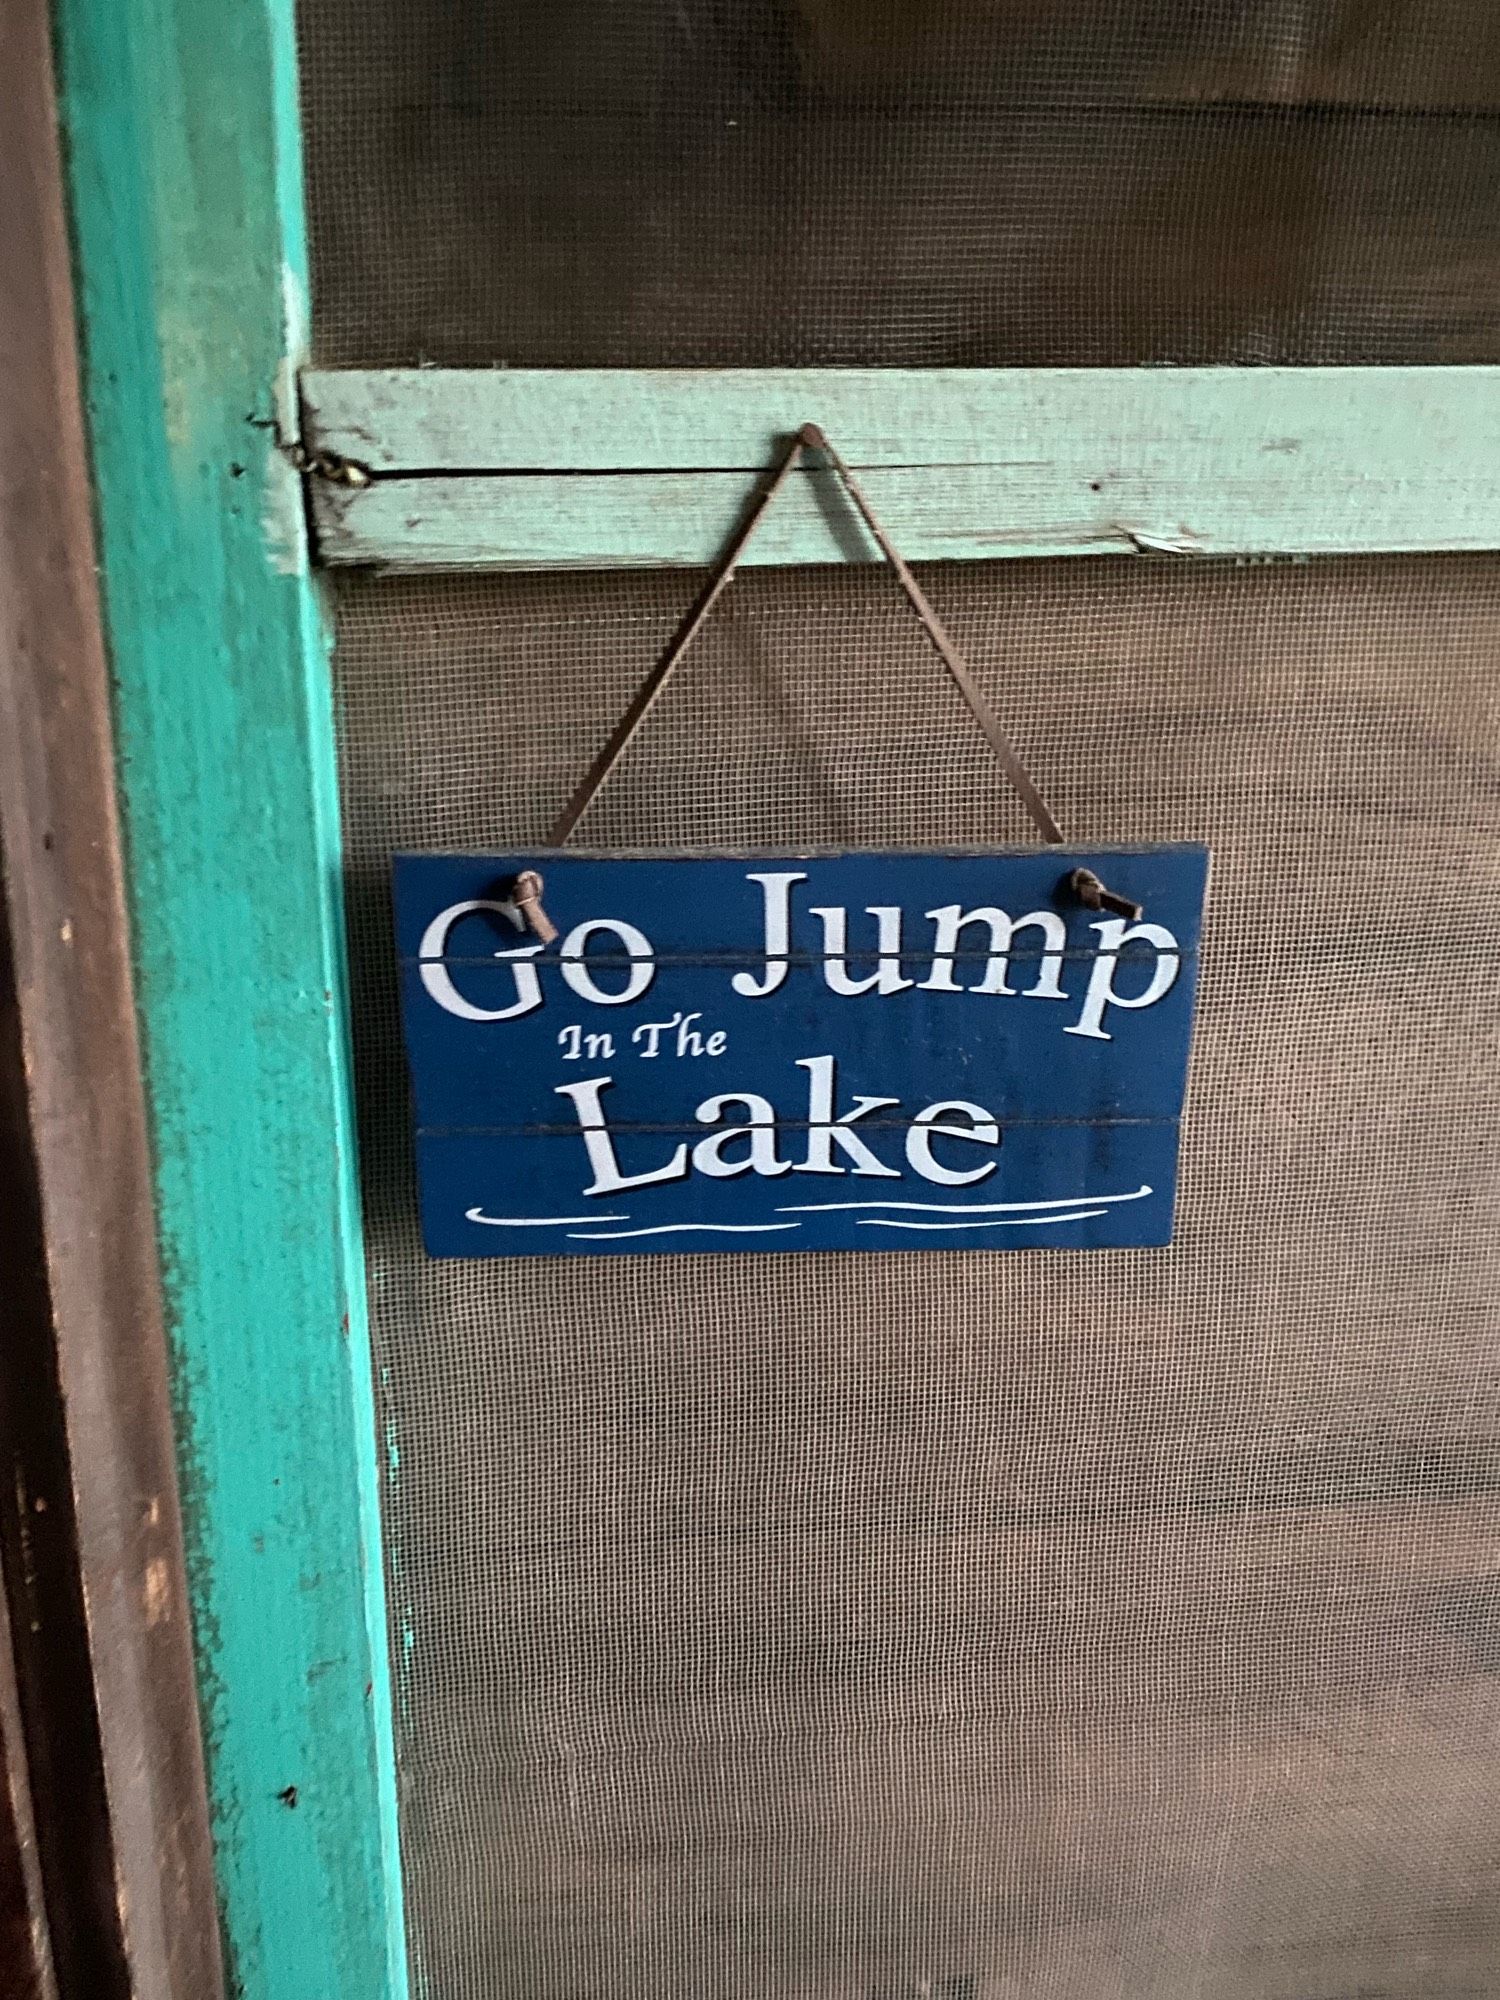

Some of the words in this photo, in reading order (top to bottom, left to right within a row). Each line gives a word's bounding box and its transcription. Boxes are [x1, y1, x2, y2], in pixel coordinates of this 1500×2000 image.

[418, 899, 655, 1022] Go
[731, 871, 1181, 1040] Jump
[557, 1023, 615, 1060] In
[632, 1012, 727, 1058] The
[554, 1055, 1000, 1196] Lake
